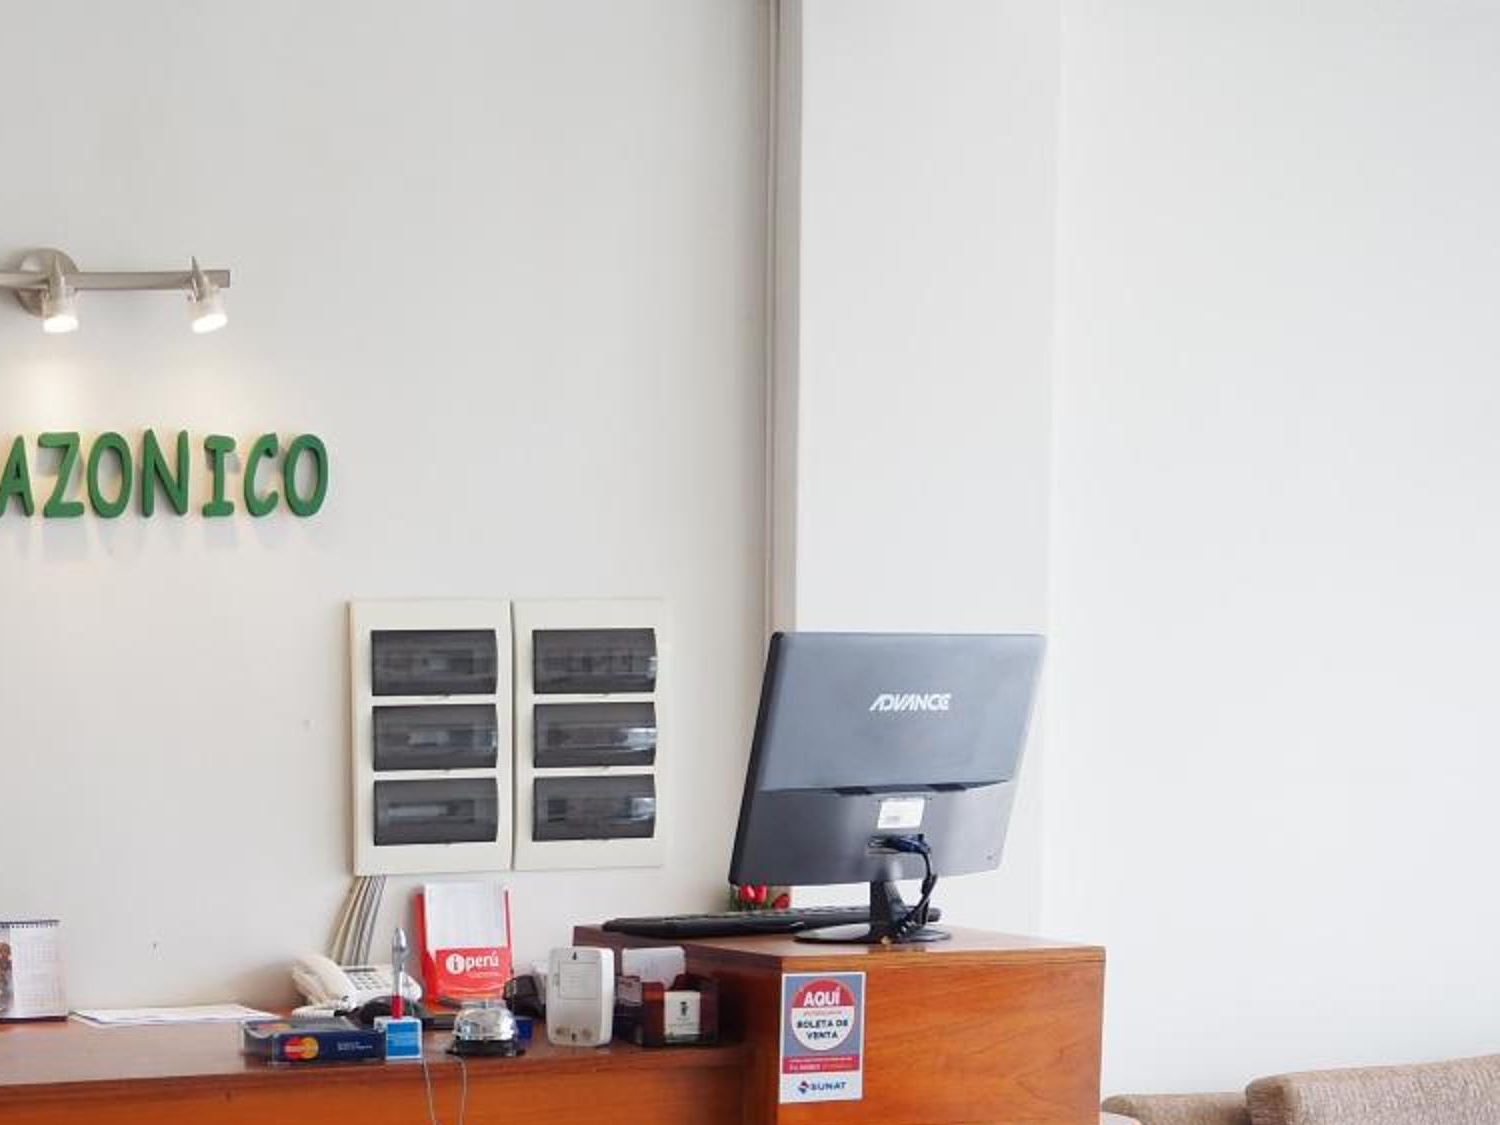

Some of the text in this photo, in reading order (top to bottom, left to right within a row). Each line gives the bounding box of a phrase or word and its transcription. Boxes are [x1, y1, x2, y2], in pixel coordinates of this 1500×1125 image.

[868, 692, 952, 713] ADVANCE
[797, 1018, 849, 1029] BOLETA DE
[806, 1031, 839, 1040] VENTA
[811, 1081, 847, 1091] SUNAT
